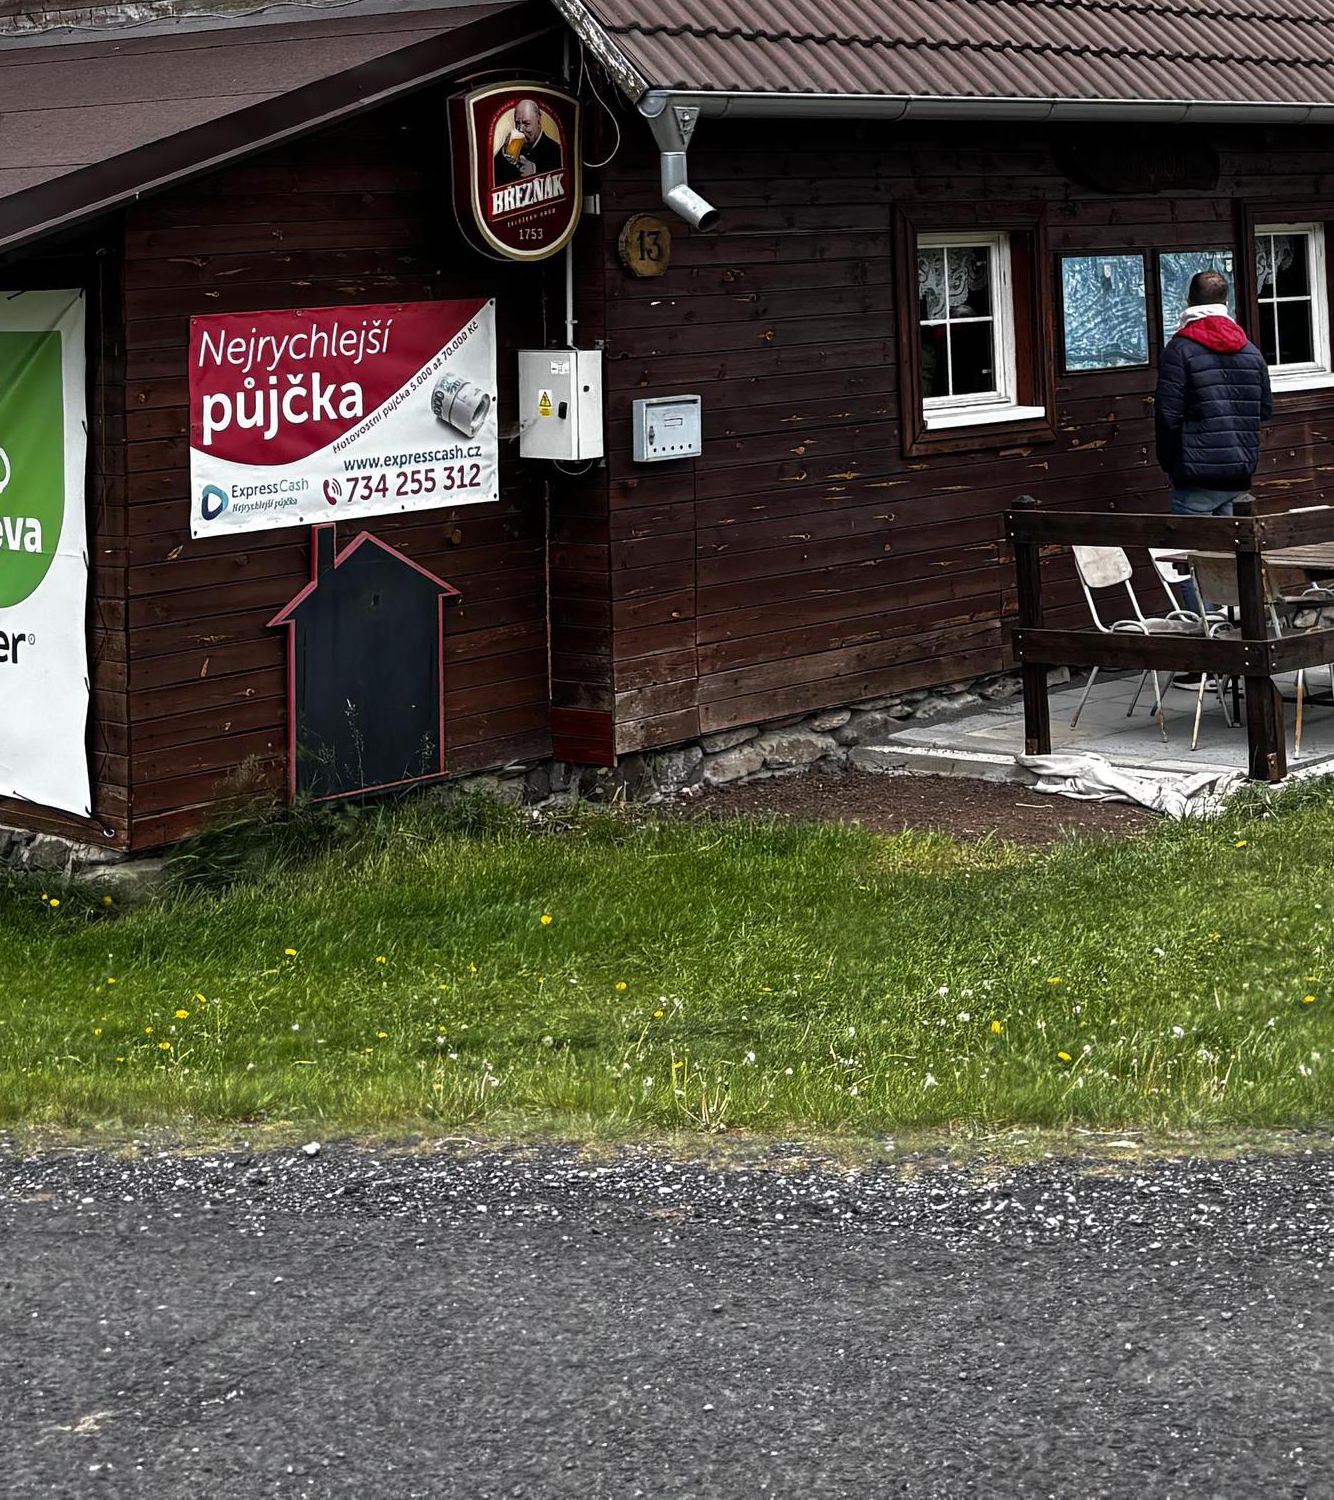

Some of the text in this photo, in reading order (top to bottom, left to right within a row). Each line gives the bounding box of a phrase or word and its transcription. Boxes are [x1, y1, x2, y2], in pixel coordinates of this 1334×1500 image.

[491, 173, 565, 216] BŘEZŇÁK
[518, 228, 544, 240] 1753
[638, 229, 661, 261] 13
[198, 319, 393, 373] Nejrychlejší
[382, 389, 411, 419] půjčka
[412, 366, 433, 392] 5.000
[441, 332, 468, 361] 70.000
[202, 372, 364, 446] půjčka
[343, 444, 482, 472] www.expresscash.cz
[231, 478, 309, 499] ExpressCash
[346, 463, 481, 503] 734 255 312
